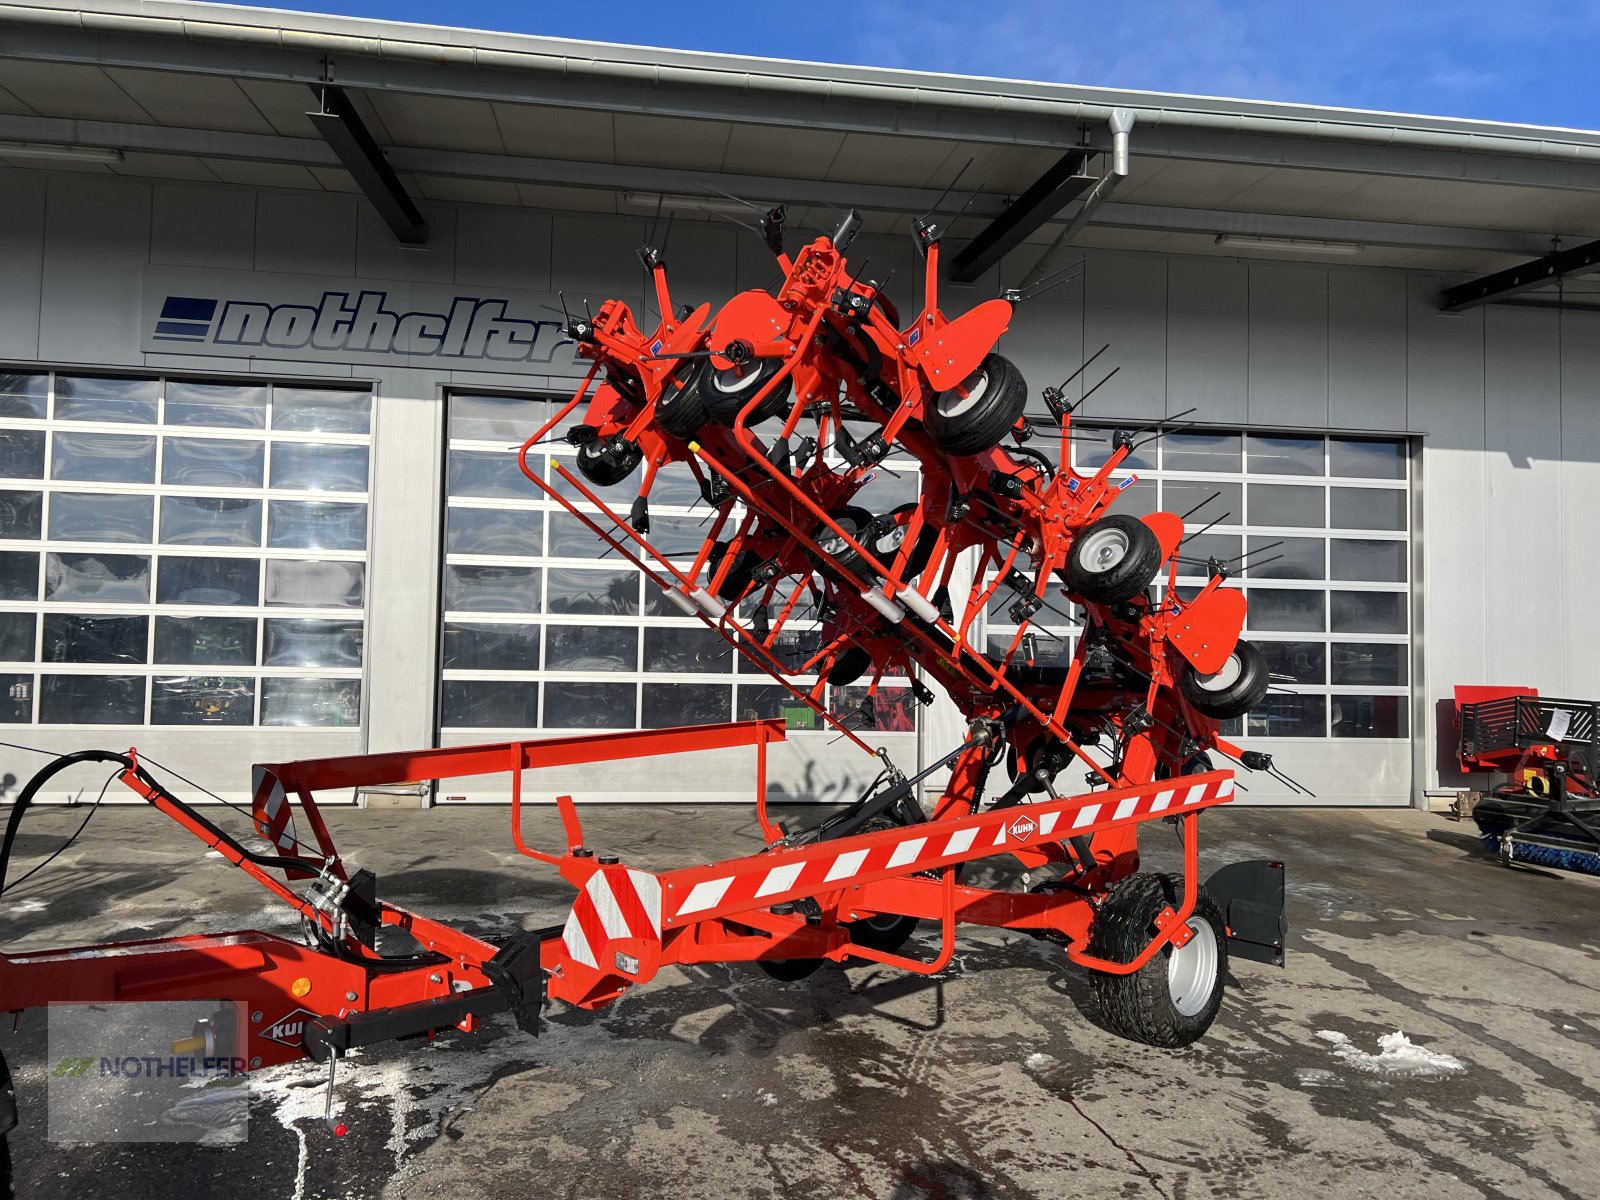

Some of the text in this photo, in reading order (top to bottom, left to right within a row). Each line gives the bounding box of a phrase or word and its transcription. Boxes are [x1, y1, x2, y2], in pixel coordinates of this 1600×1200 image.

[213, 290, 577, 363] nothelfer
[1012, 822, 1034, 836] KUHN
[272, 1021, 304, 1039] KU
